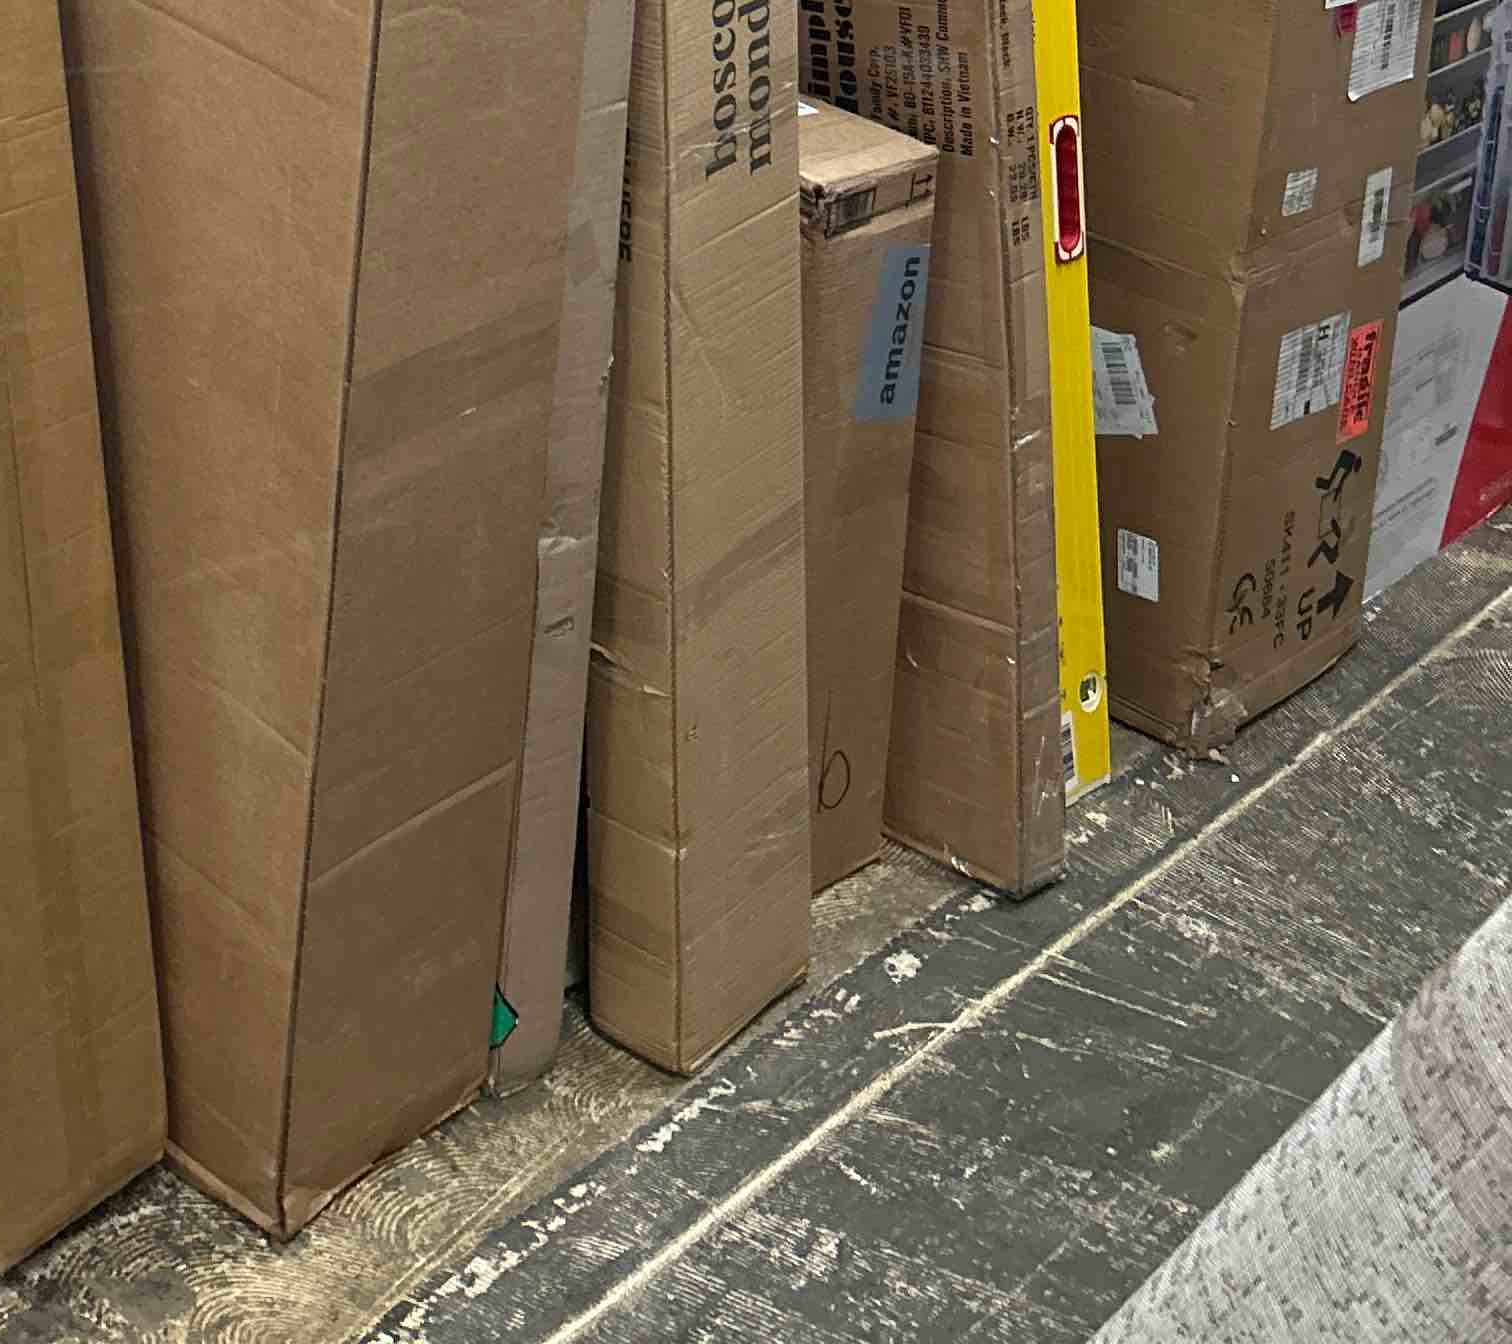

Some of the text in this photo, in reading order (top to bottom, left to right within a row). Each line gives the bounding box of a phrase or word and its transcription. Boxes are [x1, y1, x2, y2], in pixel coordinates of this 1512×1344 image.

[955, 51, 974, 157] Made in Vietnam
[879, 255, 921, 405] amazon
[1296, 586, 1316, 641] UP
